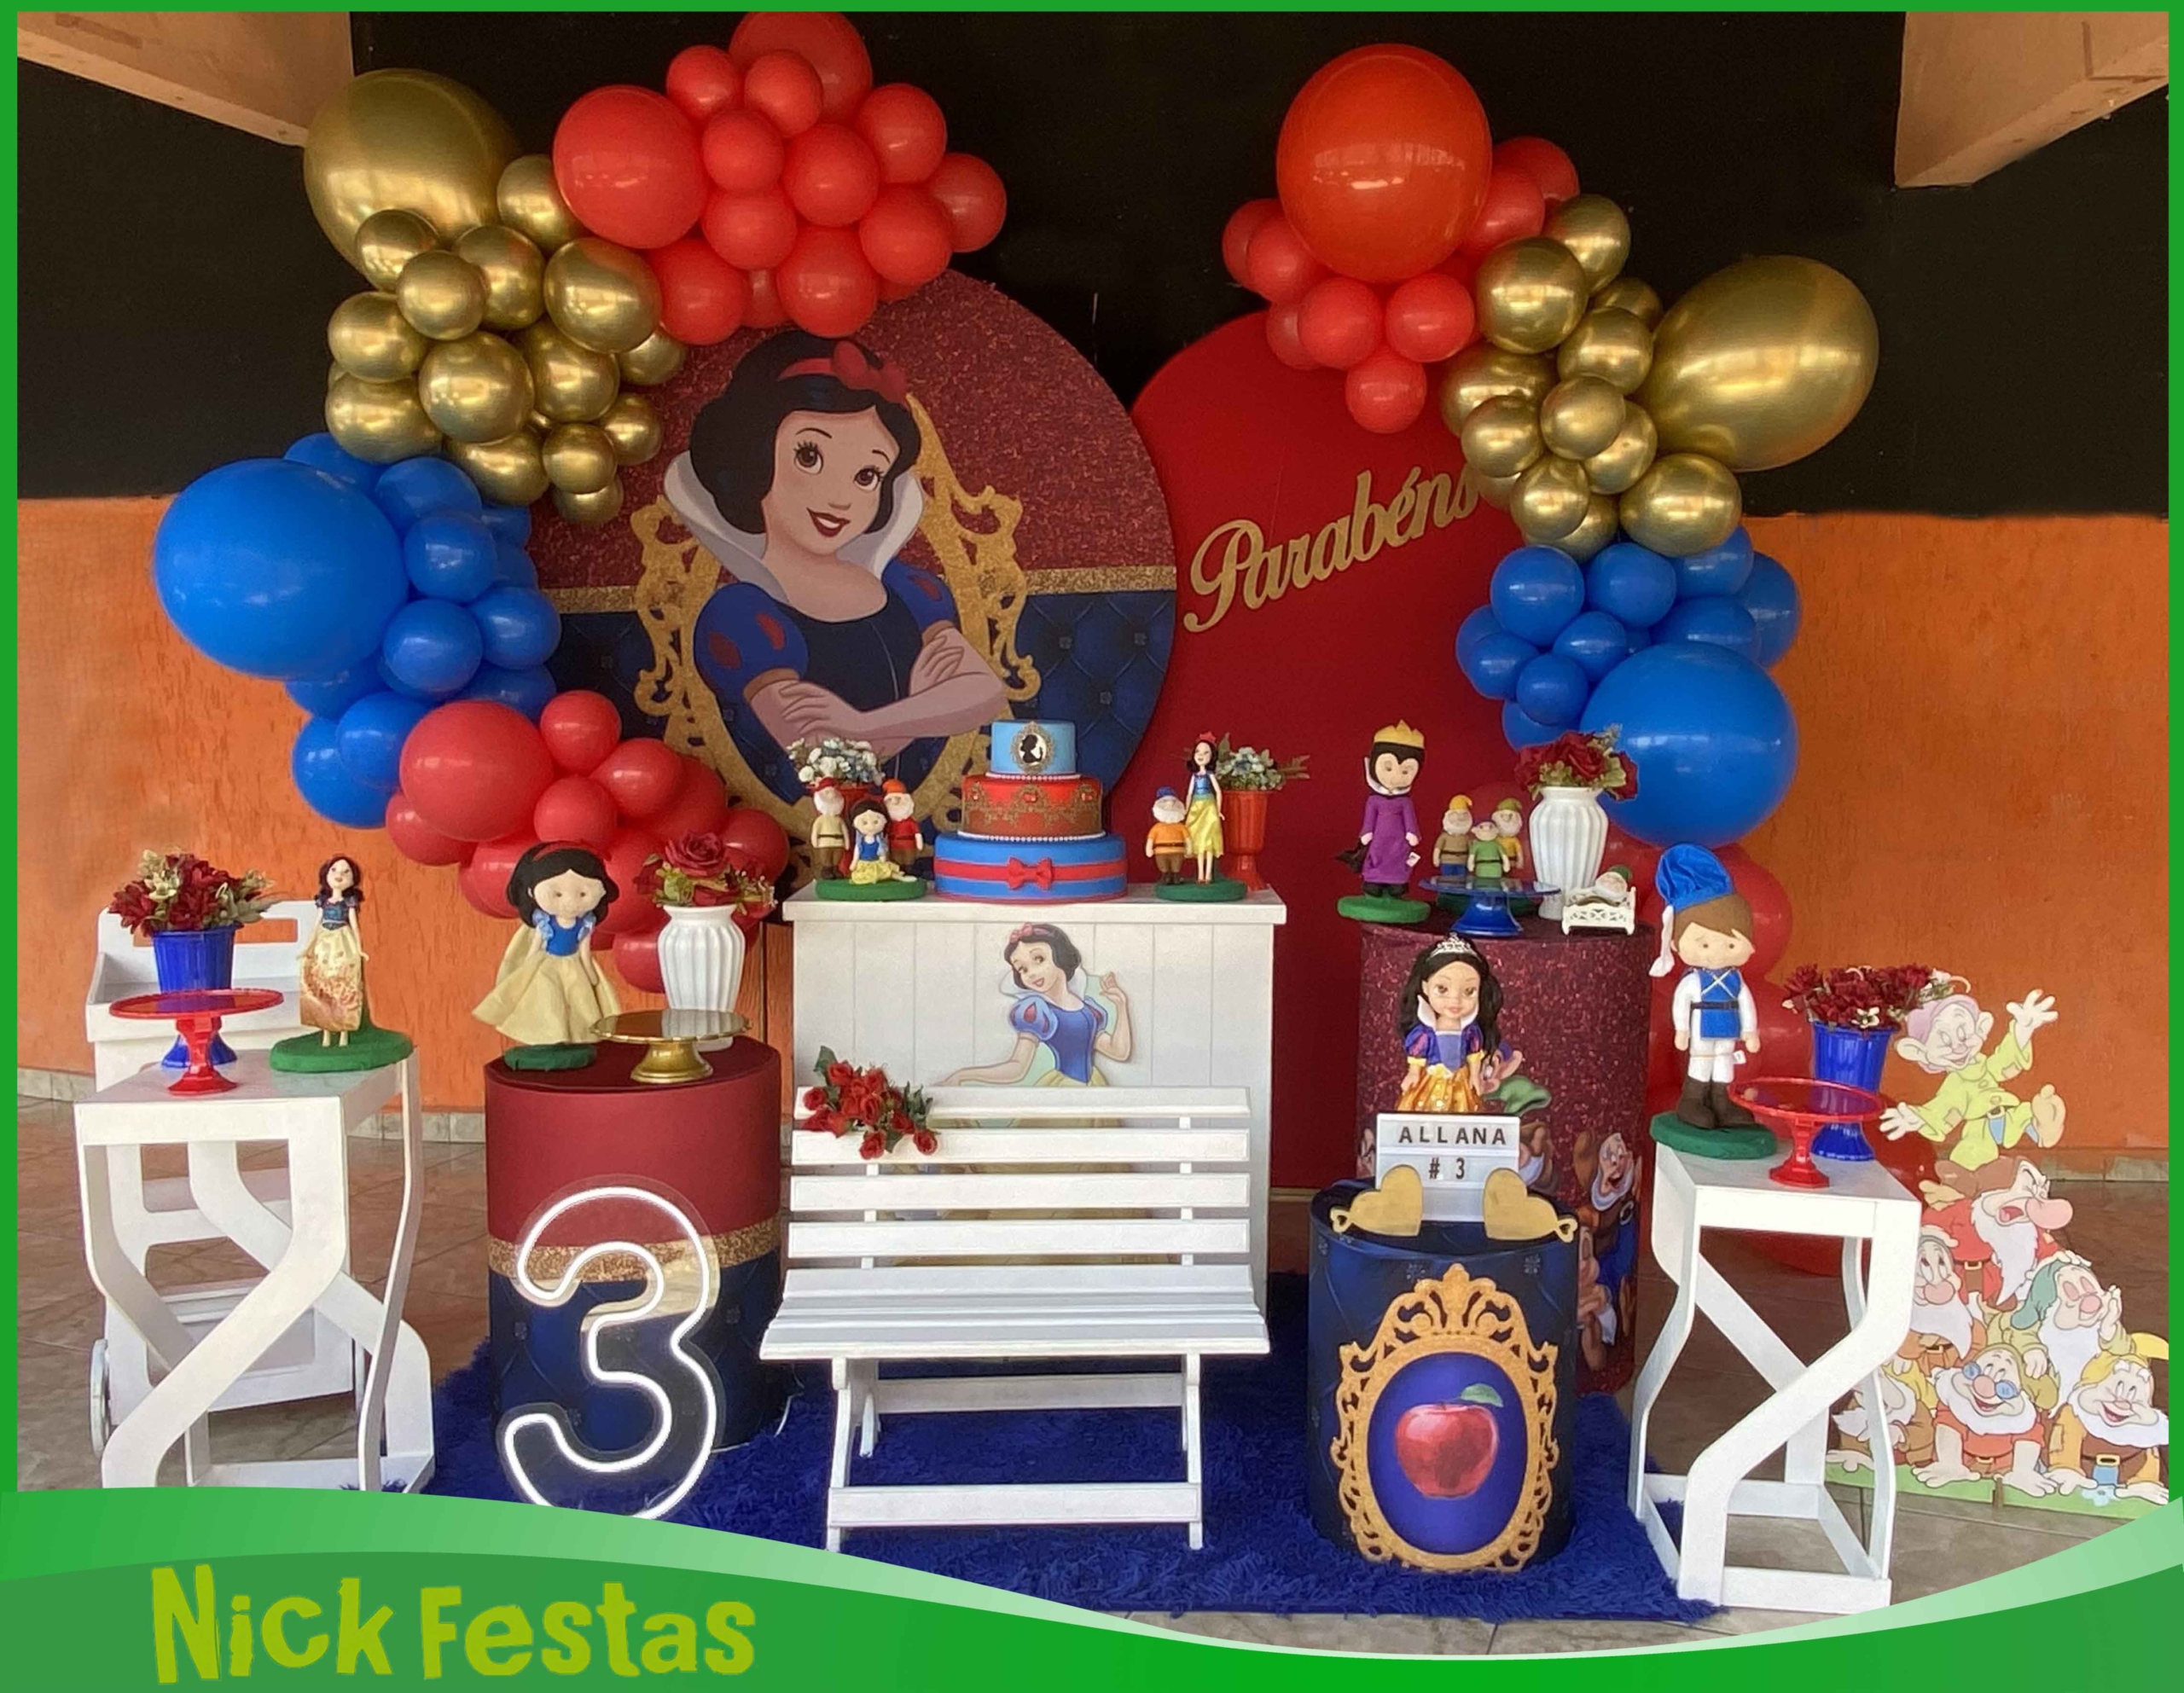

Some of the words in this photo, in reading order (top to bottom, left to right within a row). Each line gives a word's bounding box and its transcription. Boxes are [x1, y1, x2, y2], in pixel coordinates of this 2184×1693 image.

[1183, 467, 1478, 632] Parabéns
[1398, 1126, 1506, 1145] ALLANA
[1428, 1157, 1440, 1180] #
[1455, 1157, 1465, 1180] 3
[503, 1186, 717, 1520] 3
